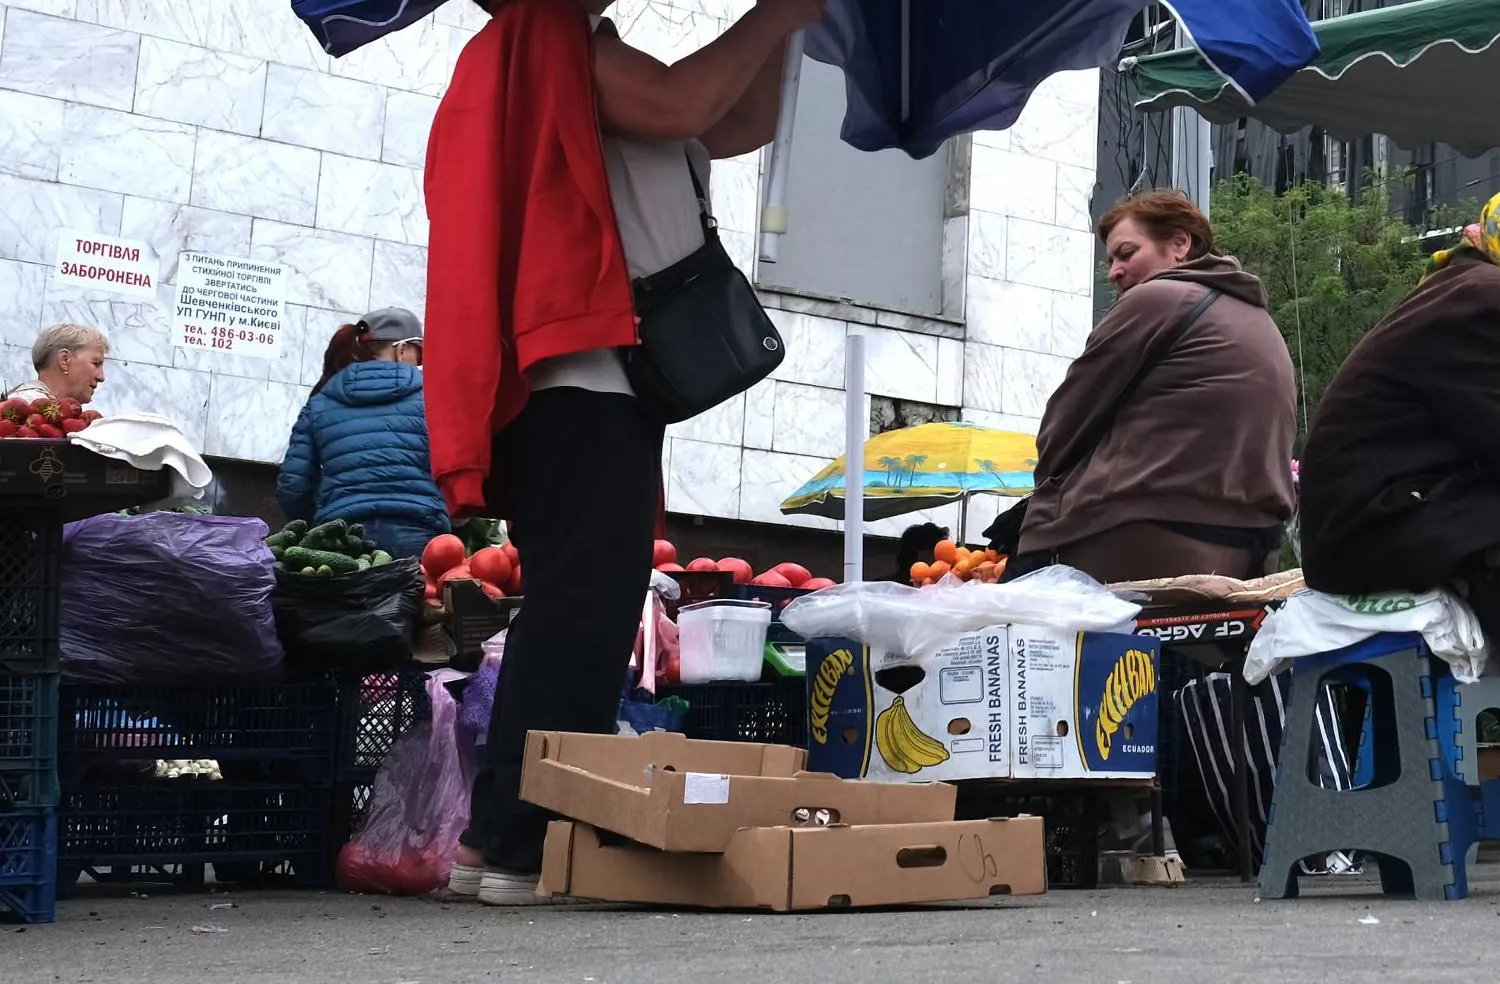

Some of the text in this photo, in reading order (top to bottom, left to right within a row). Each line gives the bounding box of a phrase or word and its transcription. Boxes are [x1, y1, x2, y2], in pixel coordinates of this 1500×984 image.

[76, 239, 140, 262] ТОРГІВЛЯ
[60, 261, 152, 288] ЗАБОРОНЕНА
[192, 255, 225, 267] ПИТАНЬ
[226, 260, 282, 276] ПРИПИНЕННЯ
[192, 265, 272, 285] СТИХІЙНОЇ ТОРГІВЛІ
[205, 278, 257, 293] ЗВЕРТАТИСЬ
[180, 294, 278, 318] Шевченківського
[181, 286, 279, 307] ДО ЧЕРГОВОЇ ЧАСТИНИ
[176, 306, 192, 317] УП
[195, 308, 226, 323] ГУНП
[228, 316, 236, 326] у
[183, 335, 233, 350] тел. 102
[184, 324, 274, 345] тел. 486-03-06
[1215, 620, 1245, 637] CF
[987, 635, 1002, 763] FRESH BANANAS
[1016, 638, 1028, 765] FRESH BANANAS
[1122, 744, 1155, 753] ECUADOR
